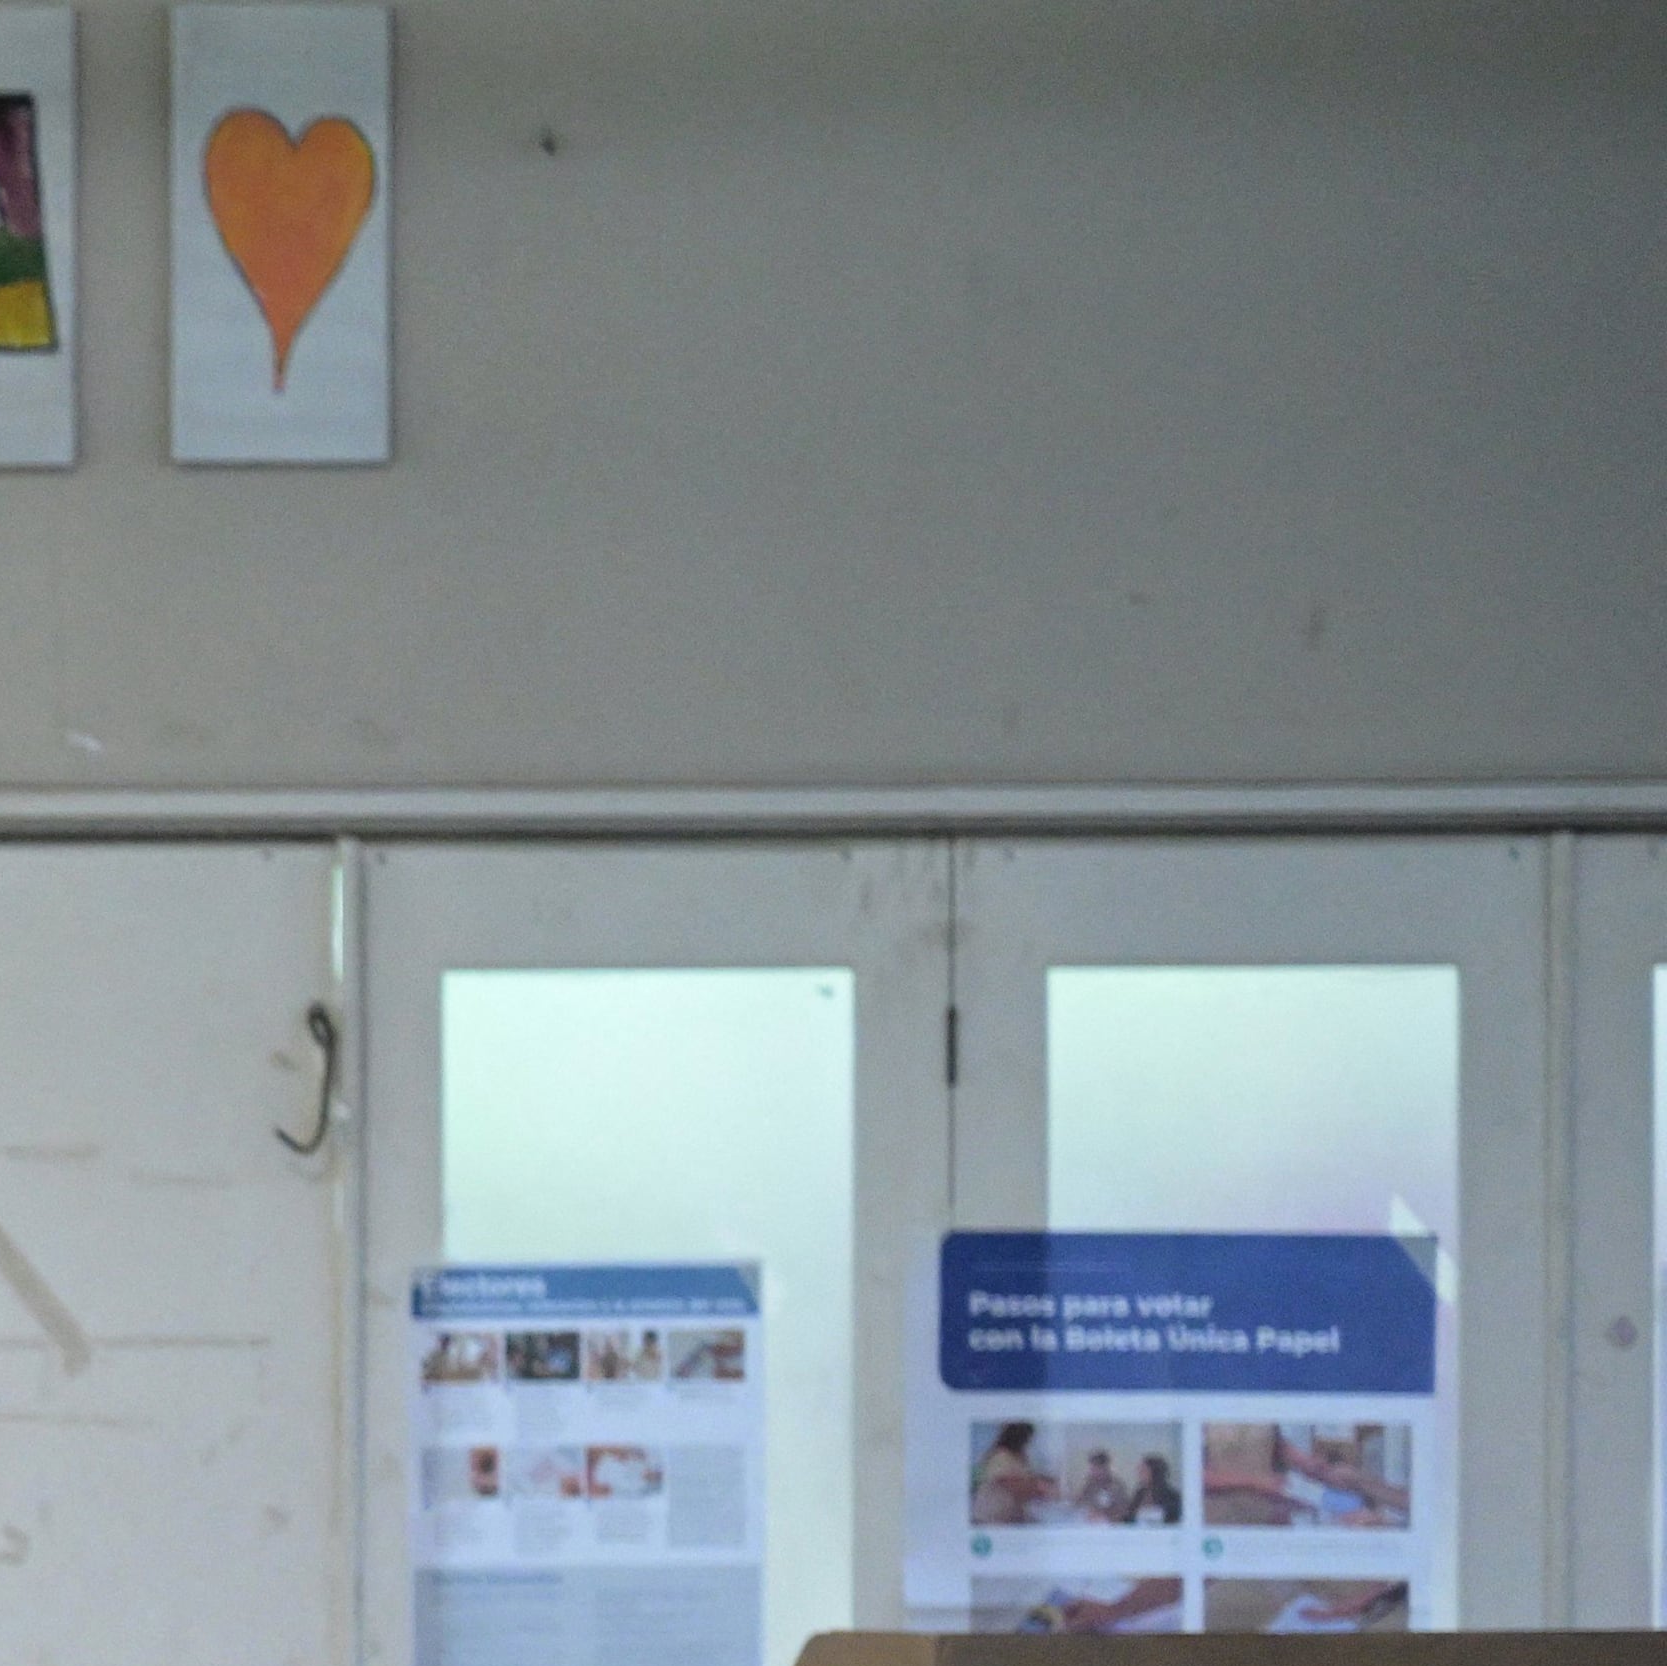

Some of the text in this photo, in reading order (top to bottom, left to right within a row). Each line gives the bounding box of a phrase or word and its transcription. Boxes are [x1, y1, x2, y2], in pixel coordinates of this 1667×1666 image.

[968, 1290, 1215, 1322] Pasos para votar
[968, 1328, 1024, 1352] con
[1030, 1324, 1057, 1352] la
[1065, 1324, 1161, 1353] Boleta
[1256, 1324, 1341, 1358] Papel
